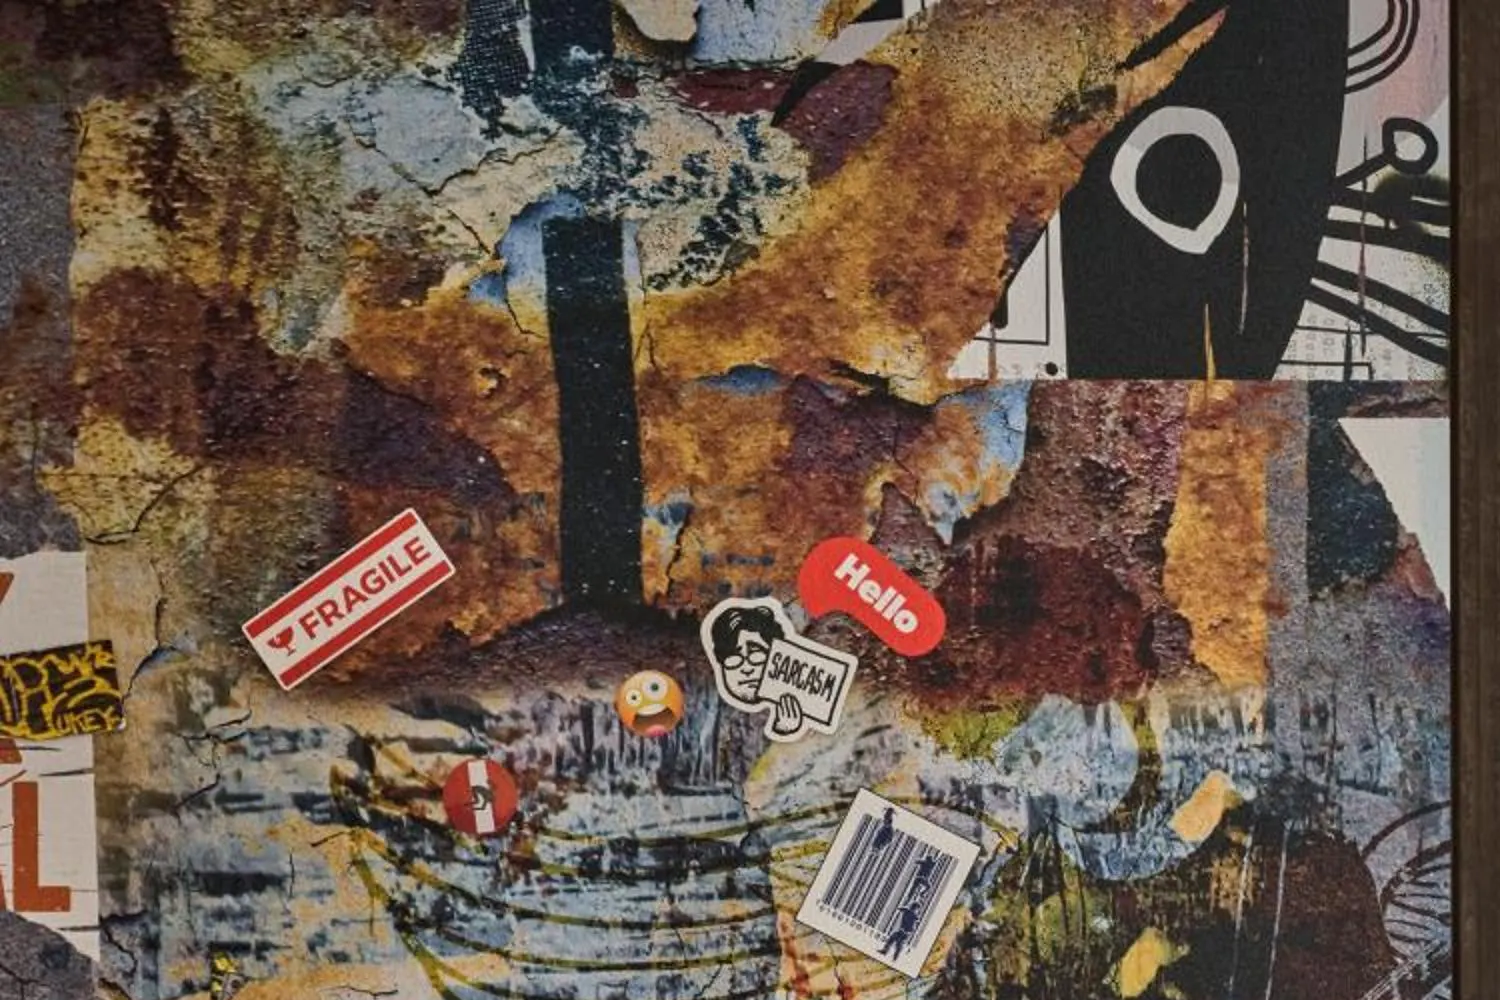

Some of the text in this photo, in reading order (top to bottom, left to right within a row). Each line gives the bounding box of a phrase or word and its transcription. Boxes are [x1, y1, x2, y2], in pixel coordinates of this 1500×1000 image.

[298, 536, 432, 640] FRAGILE
[834, 553, 919, 634] Hello
[767, 652, 837, 702] SARCASM
